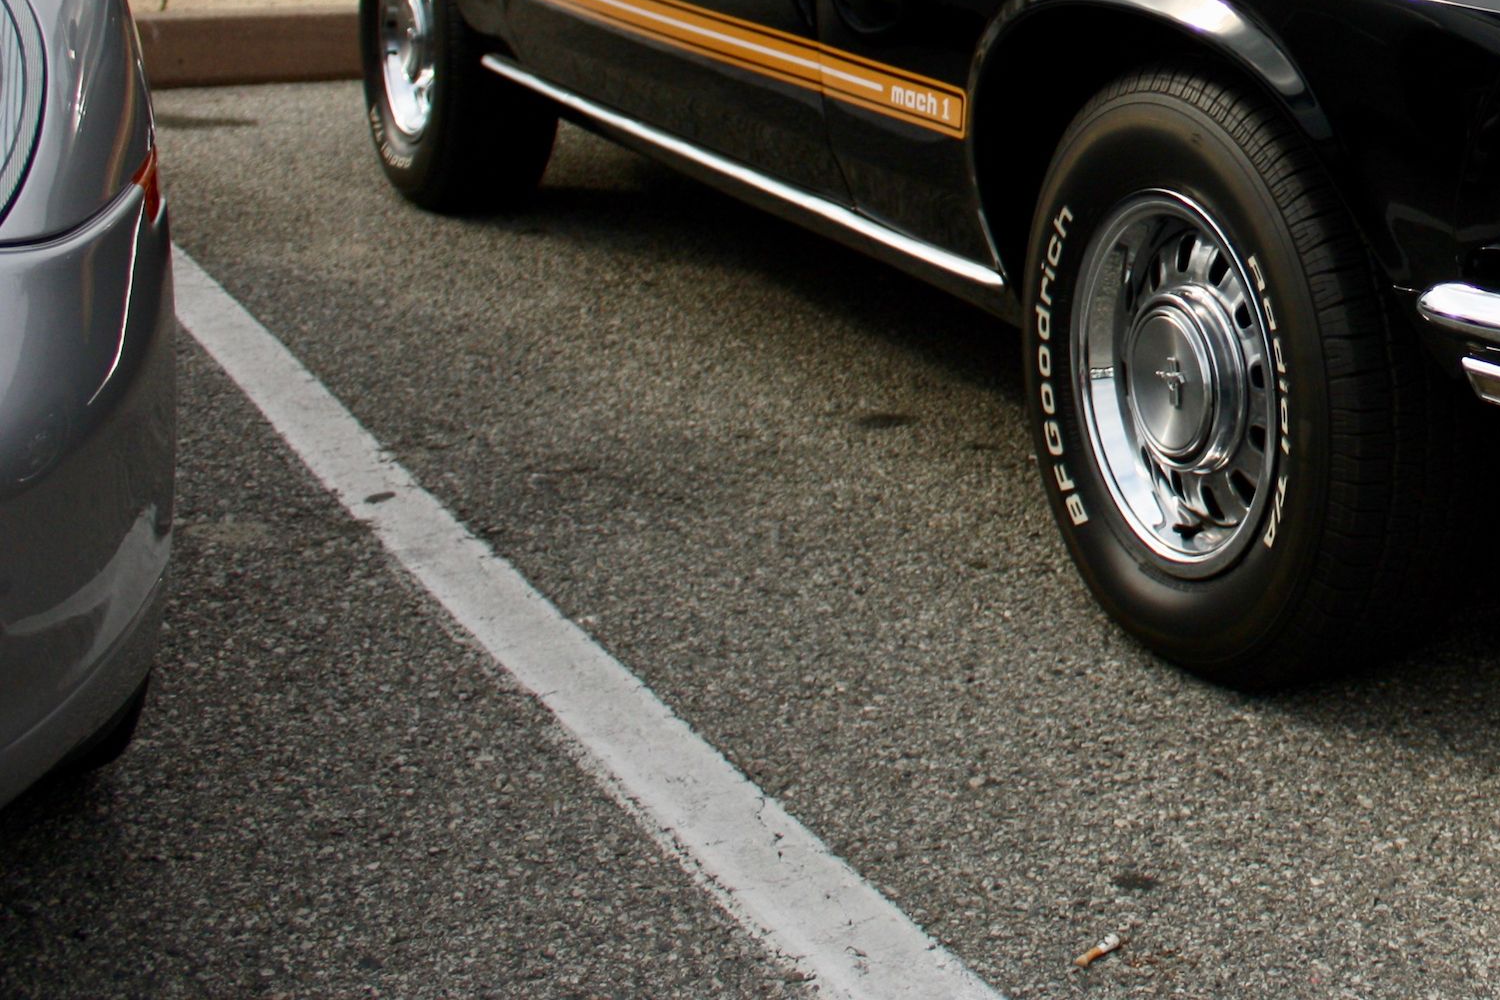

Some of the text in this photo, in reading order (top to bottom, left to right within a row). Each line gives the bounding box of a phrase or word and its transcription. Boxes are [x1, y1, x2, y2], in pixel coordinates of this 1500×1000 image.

[890, 85, 951, 121] mach 1
[1035, 204, 1089, 526] BFGoodrich
[1248, 255, 1290, 549] Radial T/A
